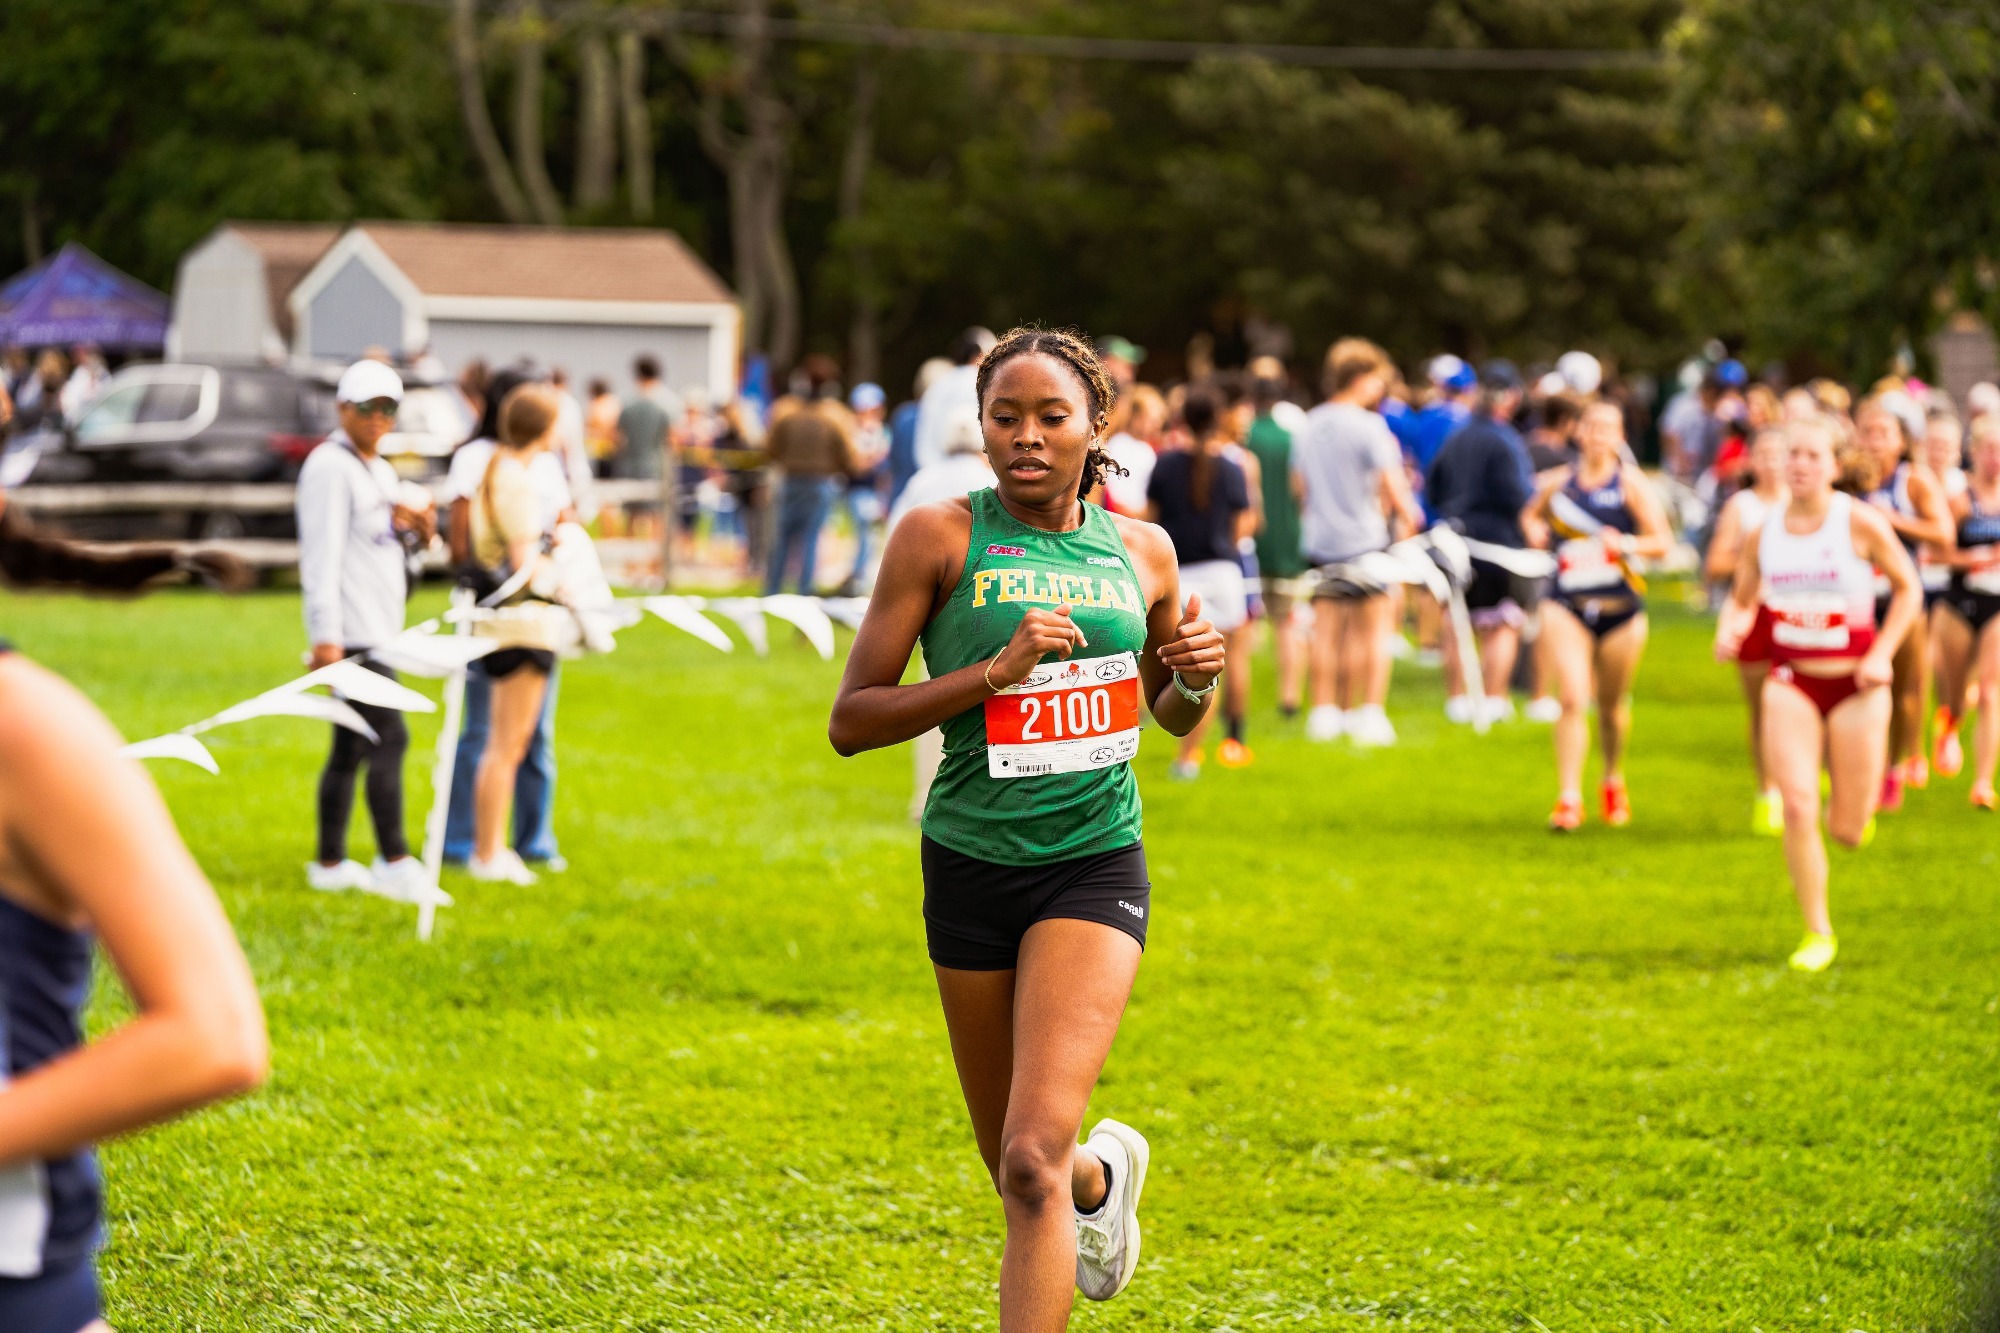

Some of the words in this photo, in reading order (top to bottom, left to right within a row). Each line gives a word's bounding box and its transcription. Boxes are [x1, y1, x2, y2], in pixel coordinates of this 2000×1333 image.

[986, 544, 1026, 557] CACC
[973, 568, 1142, 618] FELICIAN
[1020, 688, 1111, 740] 2100
